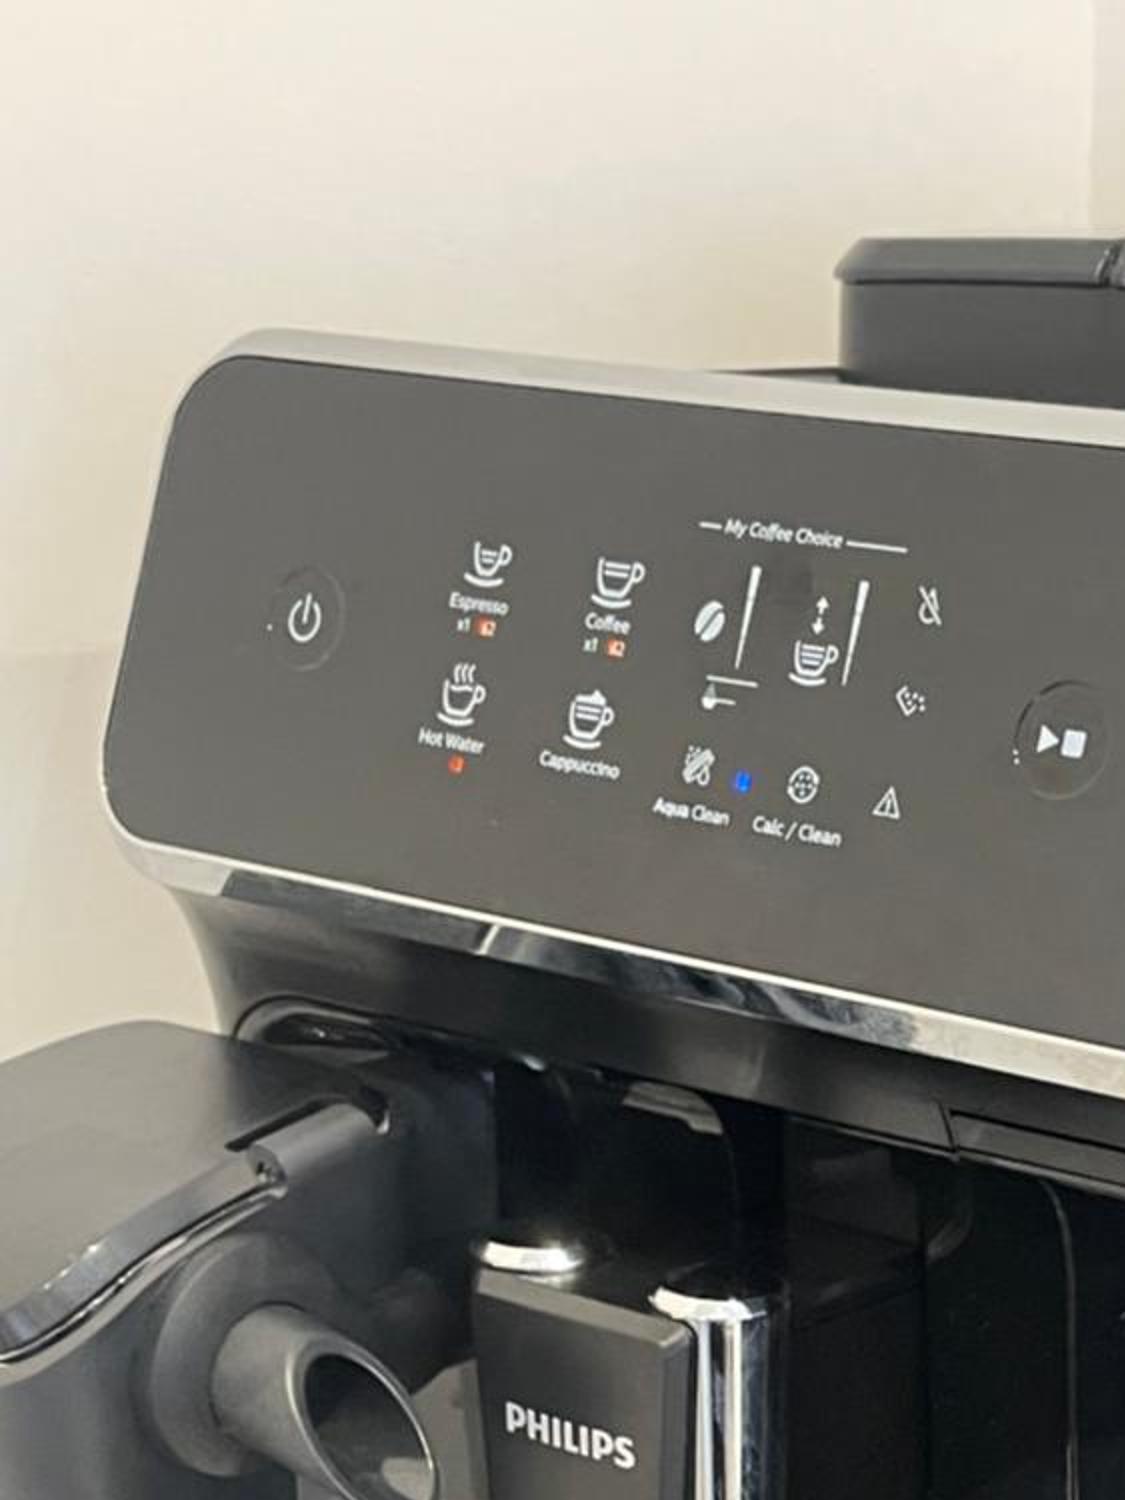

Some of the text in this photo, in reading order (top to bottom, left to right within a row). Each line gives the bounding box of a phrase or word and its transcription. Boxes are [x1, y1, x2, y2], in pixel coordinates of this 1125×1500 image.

[724, 518, 844, 549] My Coffee Choice
[449, 591, 510, 616] Espresso
[584, 611, 631, 635] Coffee
[418, 727, 485, 754] Hot Water
[539, 749, 621, 780] Cappuccino
[652, 797, 731, 826] Aqua Clean
[751, 815, 785, 837] Calc
[798, 823, 843, 847] Clean
[505, 1400, 636, 1470] PHILIPS
